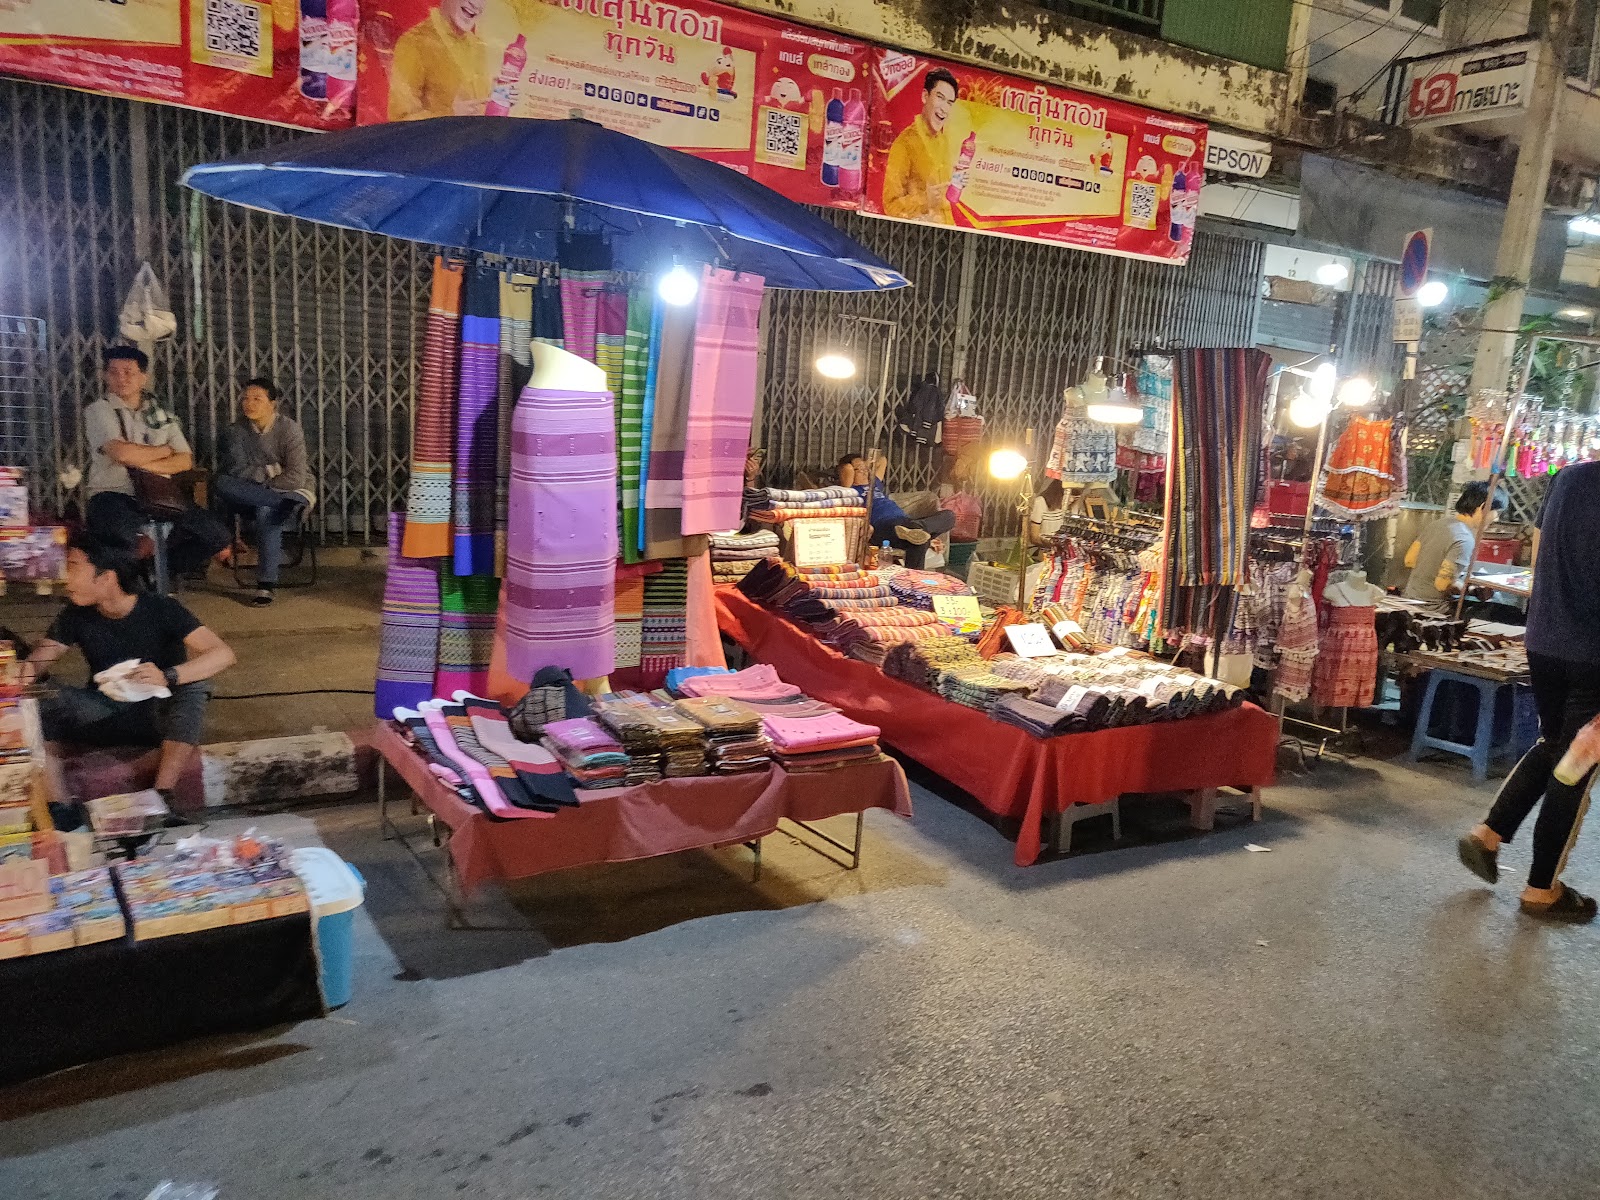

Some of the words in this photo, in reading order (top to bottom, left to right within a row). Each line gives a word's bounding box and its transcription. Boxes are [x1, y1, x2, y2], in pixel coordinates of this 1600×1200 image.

[606, 32, 675, 63] ทุกวัน
[1028, 125, 1074, 149] ทุกวัน
[1207, 144, 1264, 175] EPSON
